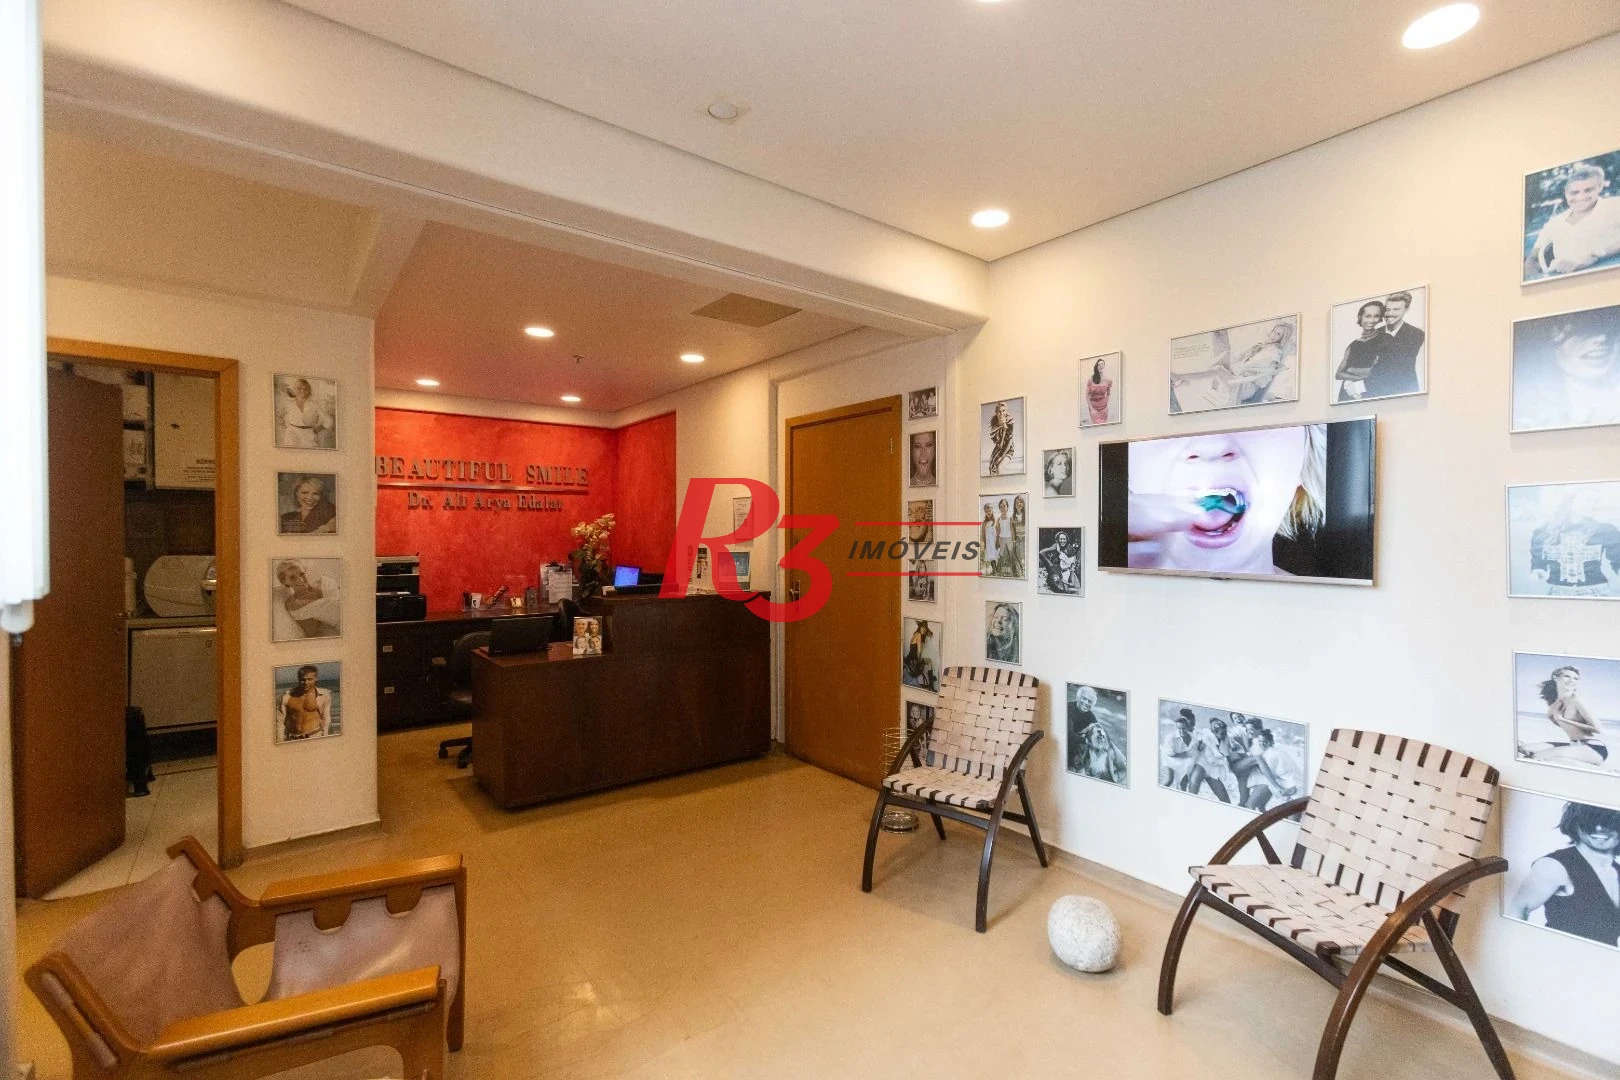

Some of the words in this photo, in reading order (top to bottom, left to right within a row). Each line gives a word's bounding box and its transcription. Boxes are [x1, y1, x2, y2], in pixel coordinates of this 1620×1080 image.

[375, 456, 512, 483] BEAUTIFUL
[526, 464, 589, 486] SMILE
[442, 493, 467, 511] Ali
